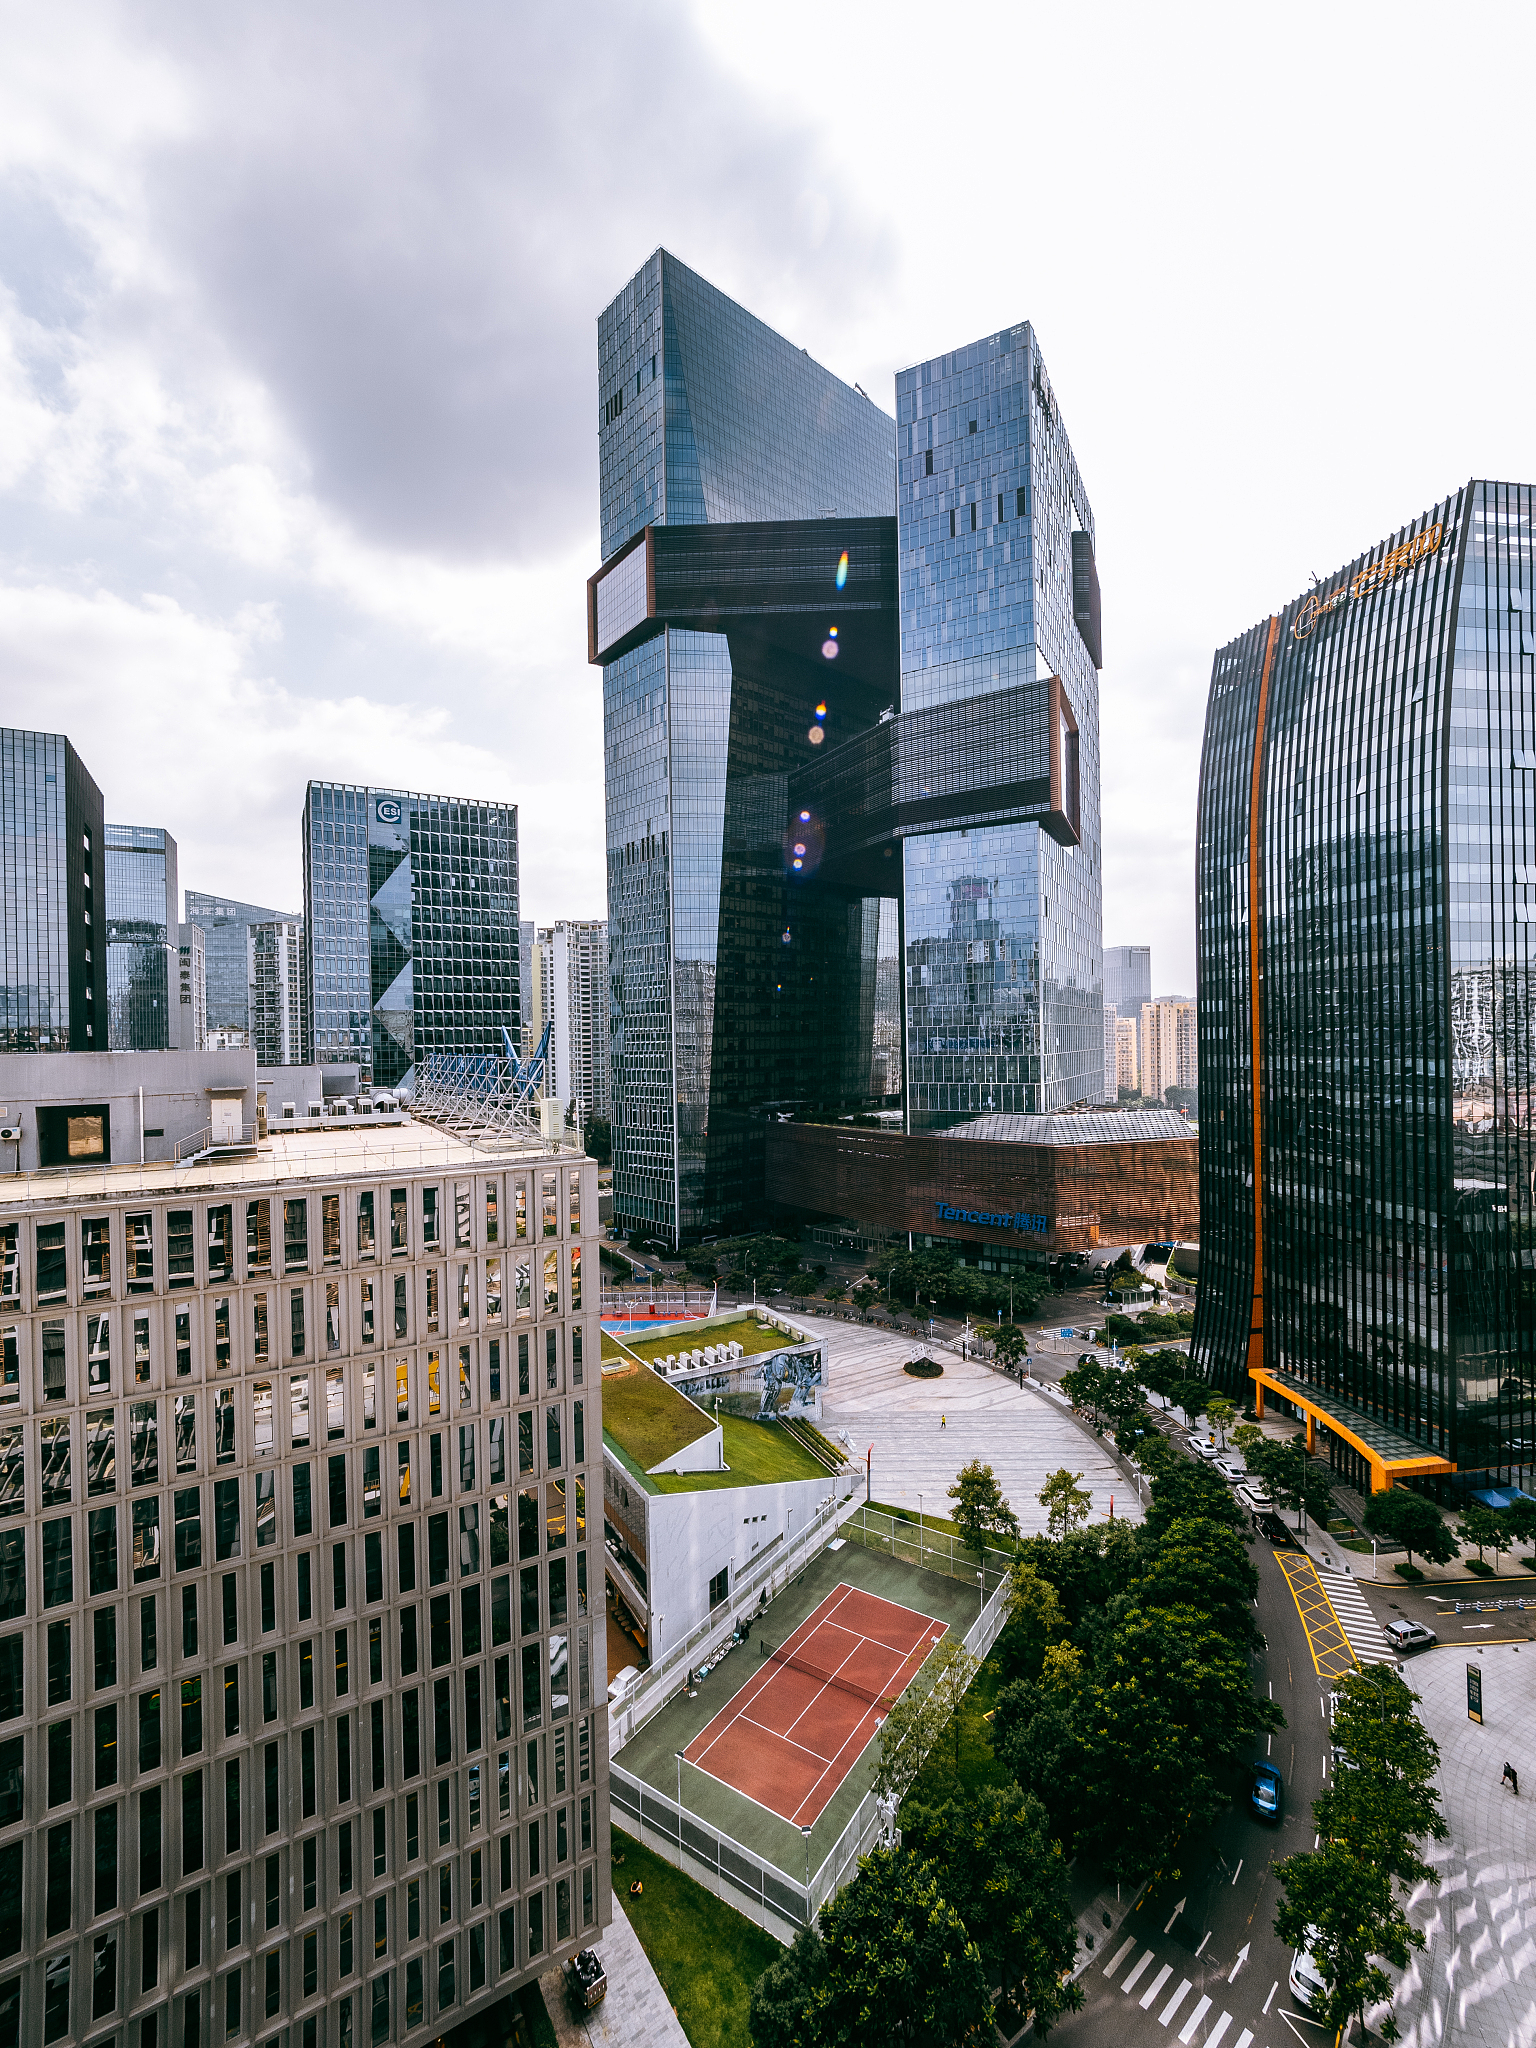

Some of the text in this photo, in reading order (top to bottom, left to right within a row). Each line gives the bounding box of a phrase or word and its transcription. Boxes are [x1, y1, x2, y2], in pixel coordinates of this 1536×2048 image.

[1352, 523, 1442, 598] 芒果网
[190, 906, 236, 916] 海岸集团
[179, 957, 191, 1005] 闽泰集团
[935, 1202, 1047, 1233] Tencent 腾讯
